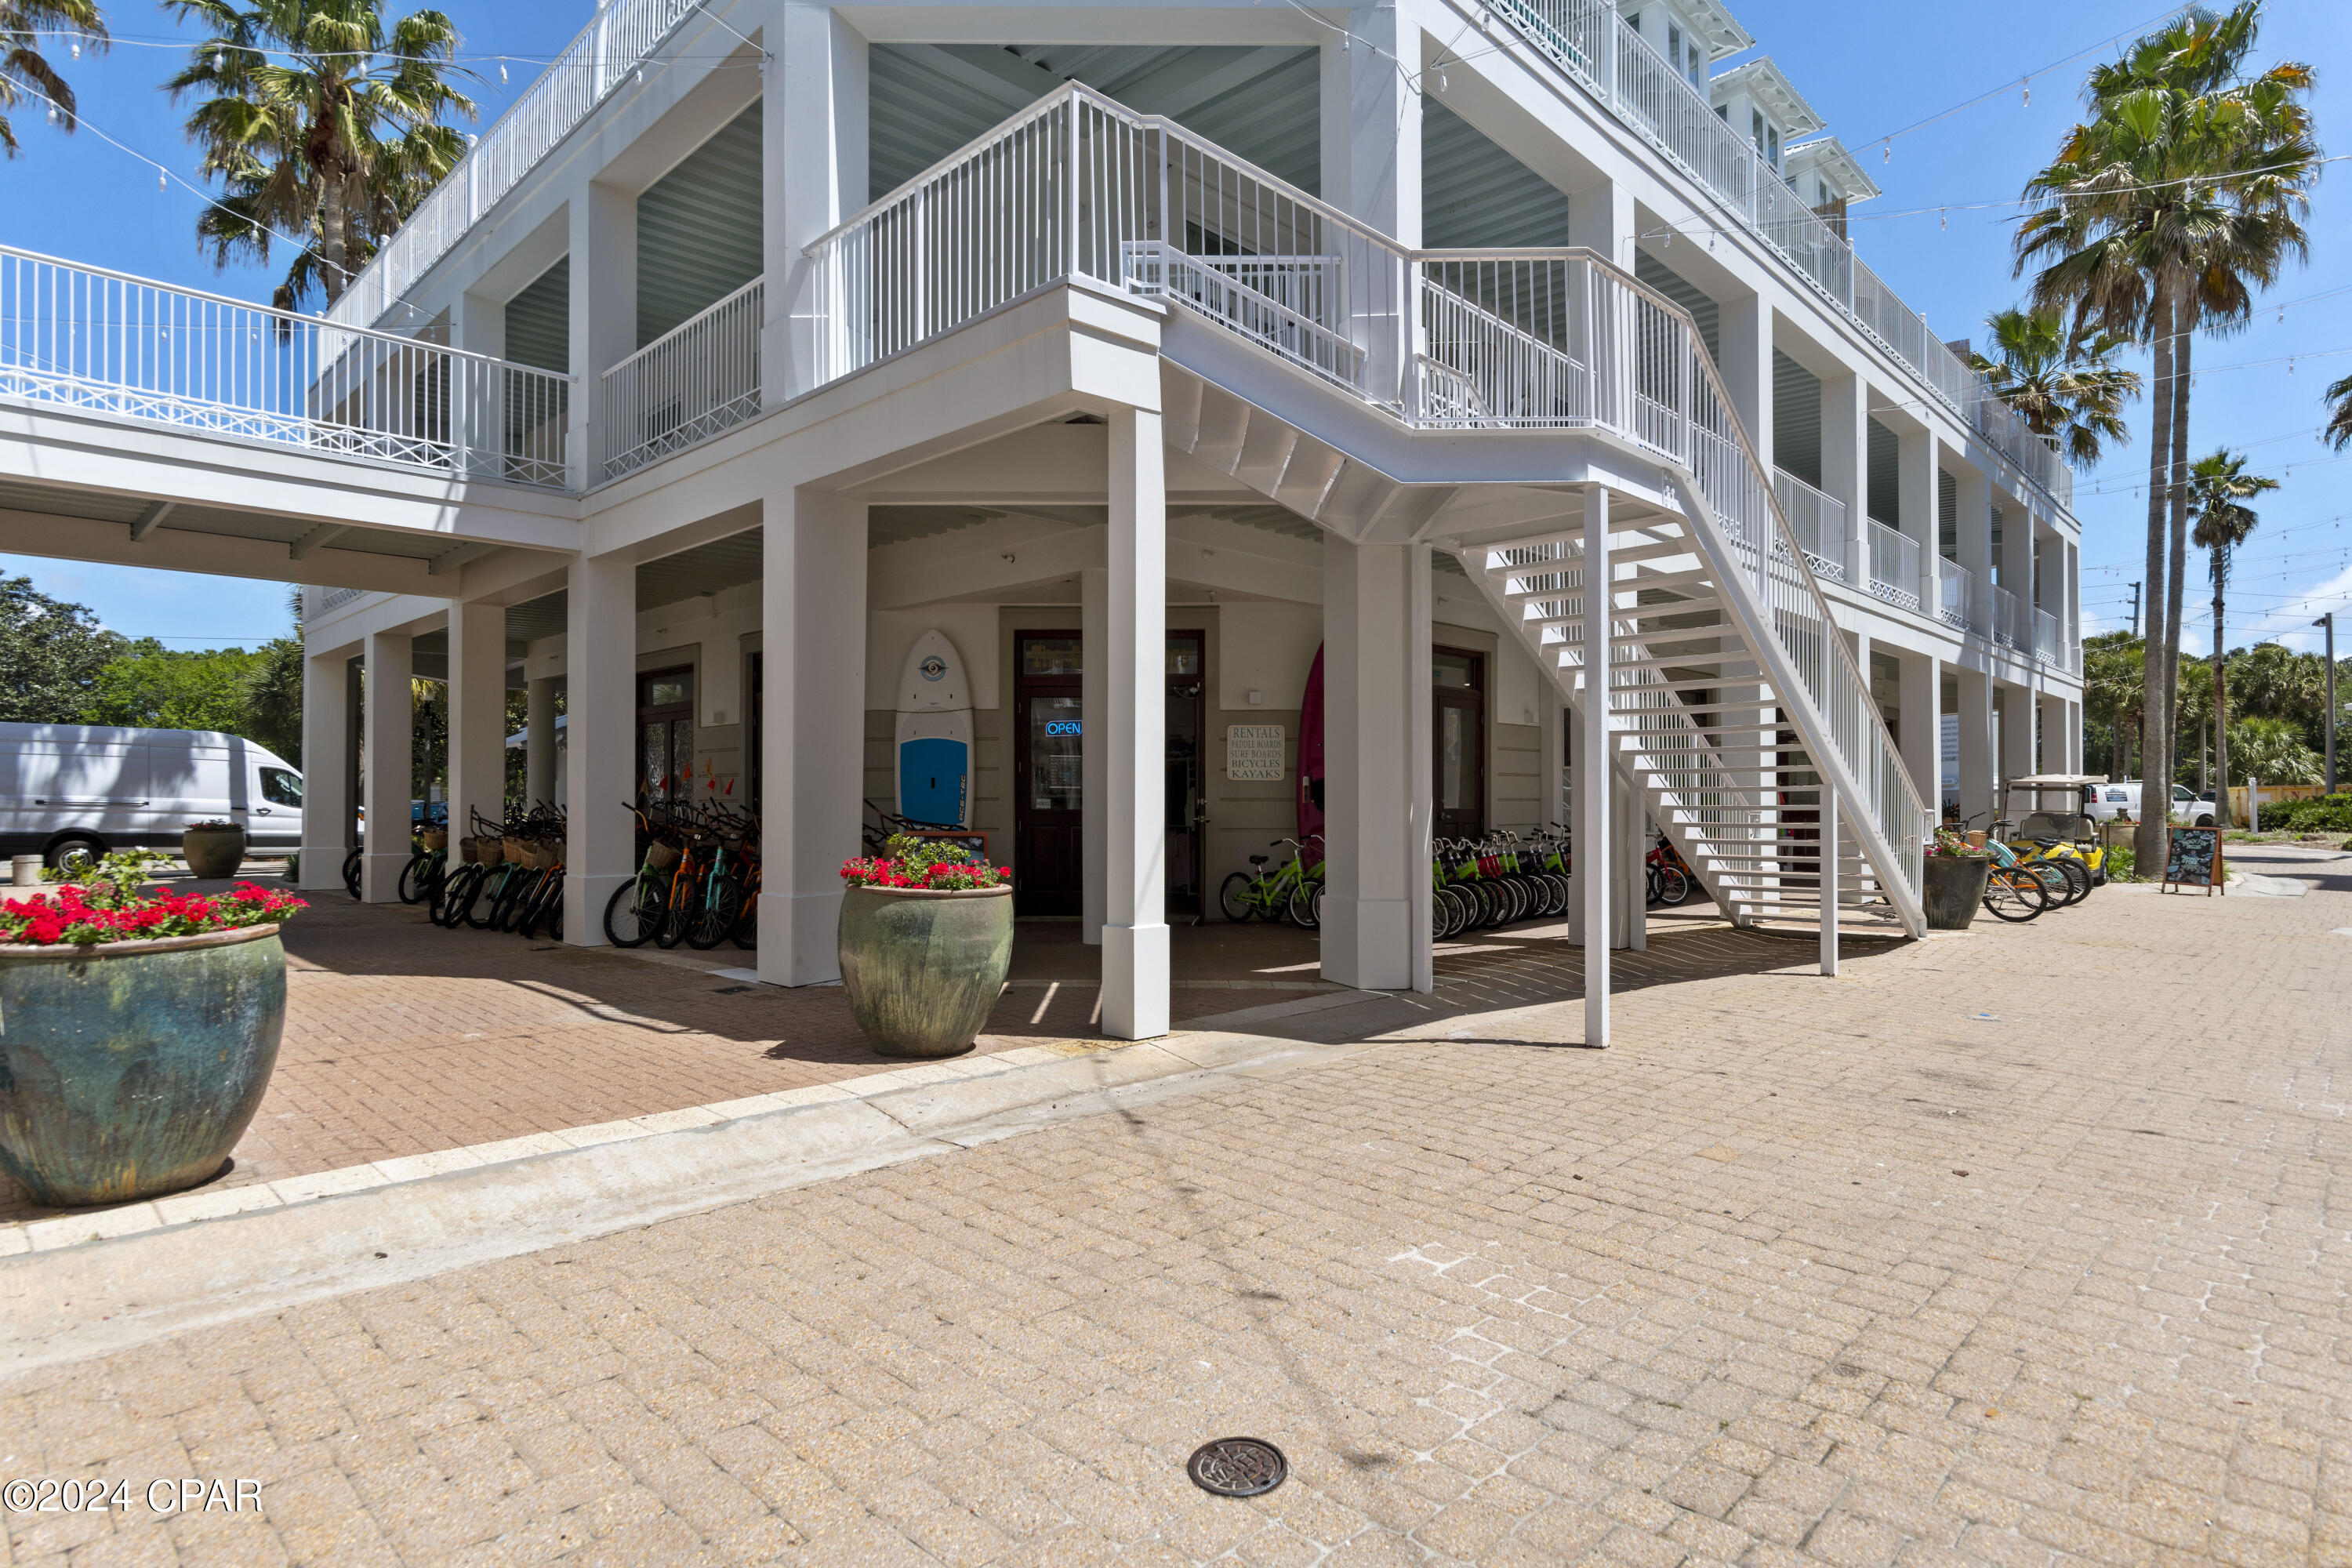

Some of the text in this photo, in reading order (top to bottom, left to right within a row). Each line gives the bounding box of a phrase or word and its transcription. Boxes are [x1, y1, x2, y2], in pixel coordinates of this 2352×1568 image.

[1047, 722, 1081, 735] OPEN
[1233, 728, 1279, 739] RENTALS
[1232, 740, 1281, 749] PADDLE BOARDS
[1232, 760, 1280, 768] BICYCLES
